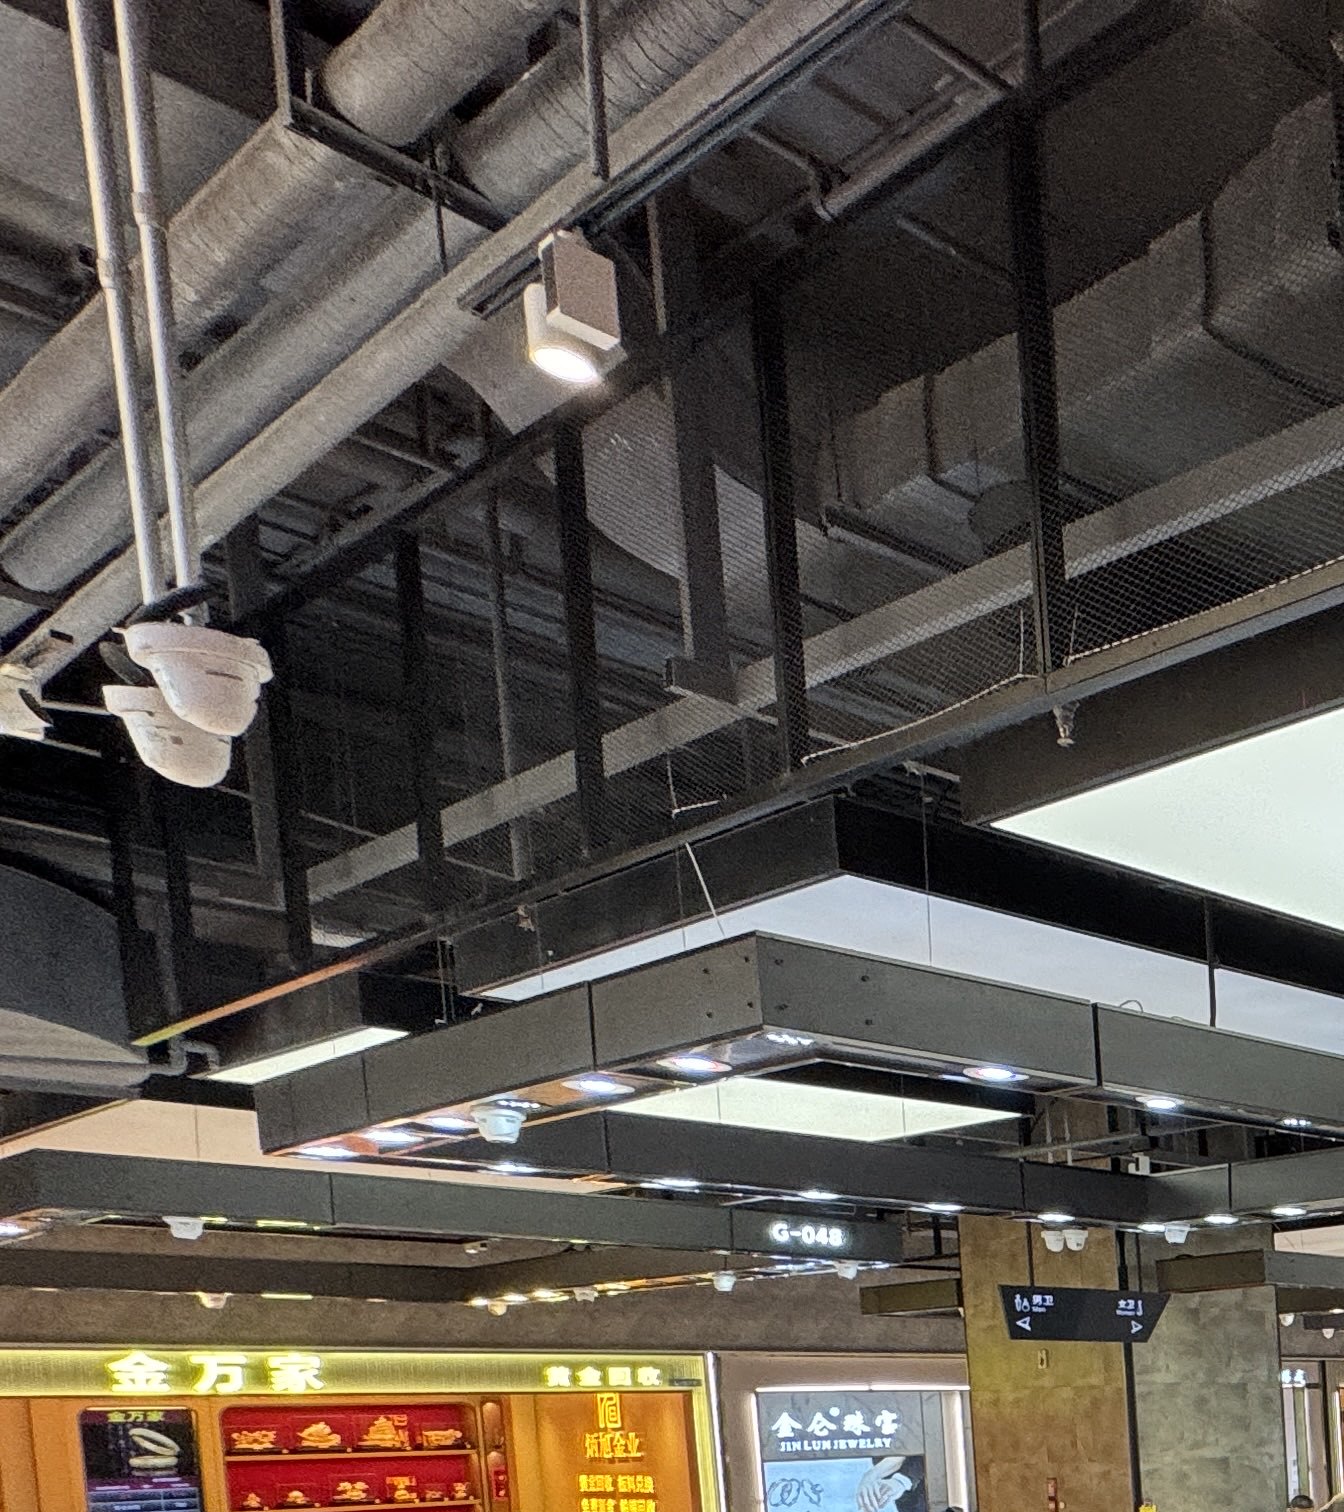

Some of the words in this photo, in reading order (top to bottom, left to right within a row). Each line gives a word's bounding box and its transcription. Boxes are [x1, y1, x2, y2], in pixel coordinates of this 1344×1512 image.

[771, 1222, 844, 1247] G-048
[107, 1352, 325, 1393] 金万家
[546, 1366, 662, 1387] 黄金回收
[780, 1441, 802, 1452] JIN
[833, 1438, 892, 1450] JEWELRY
